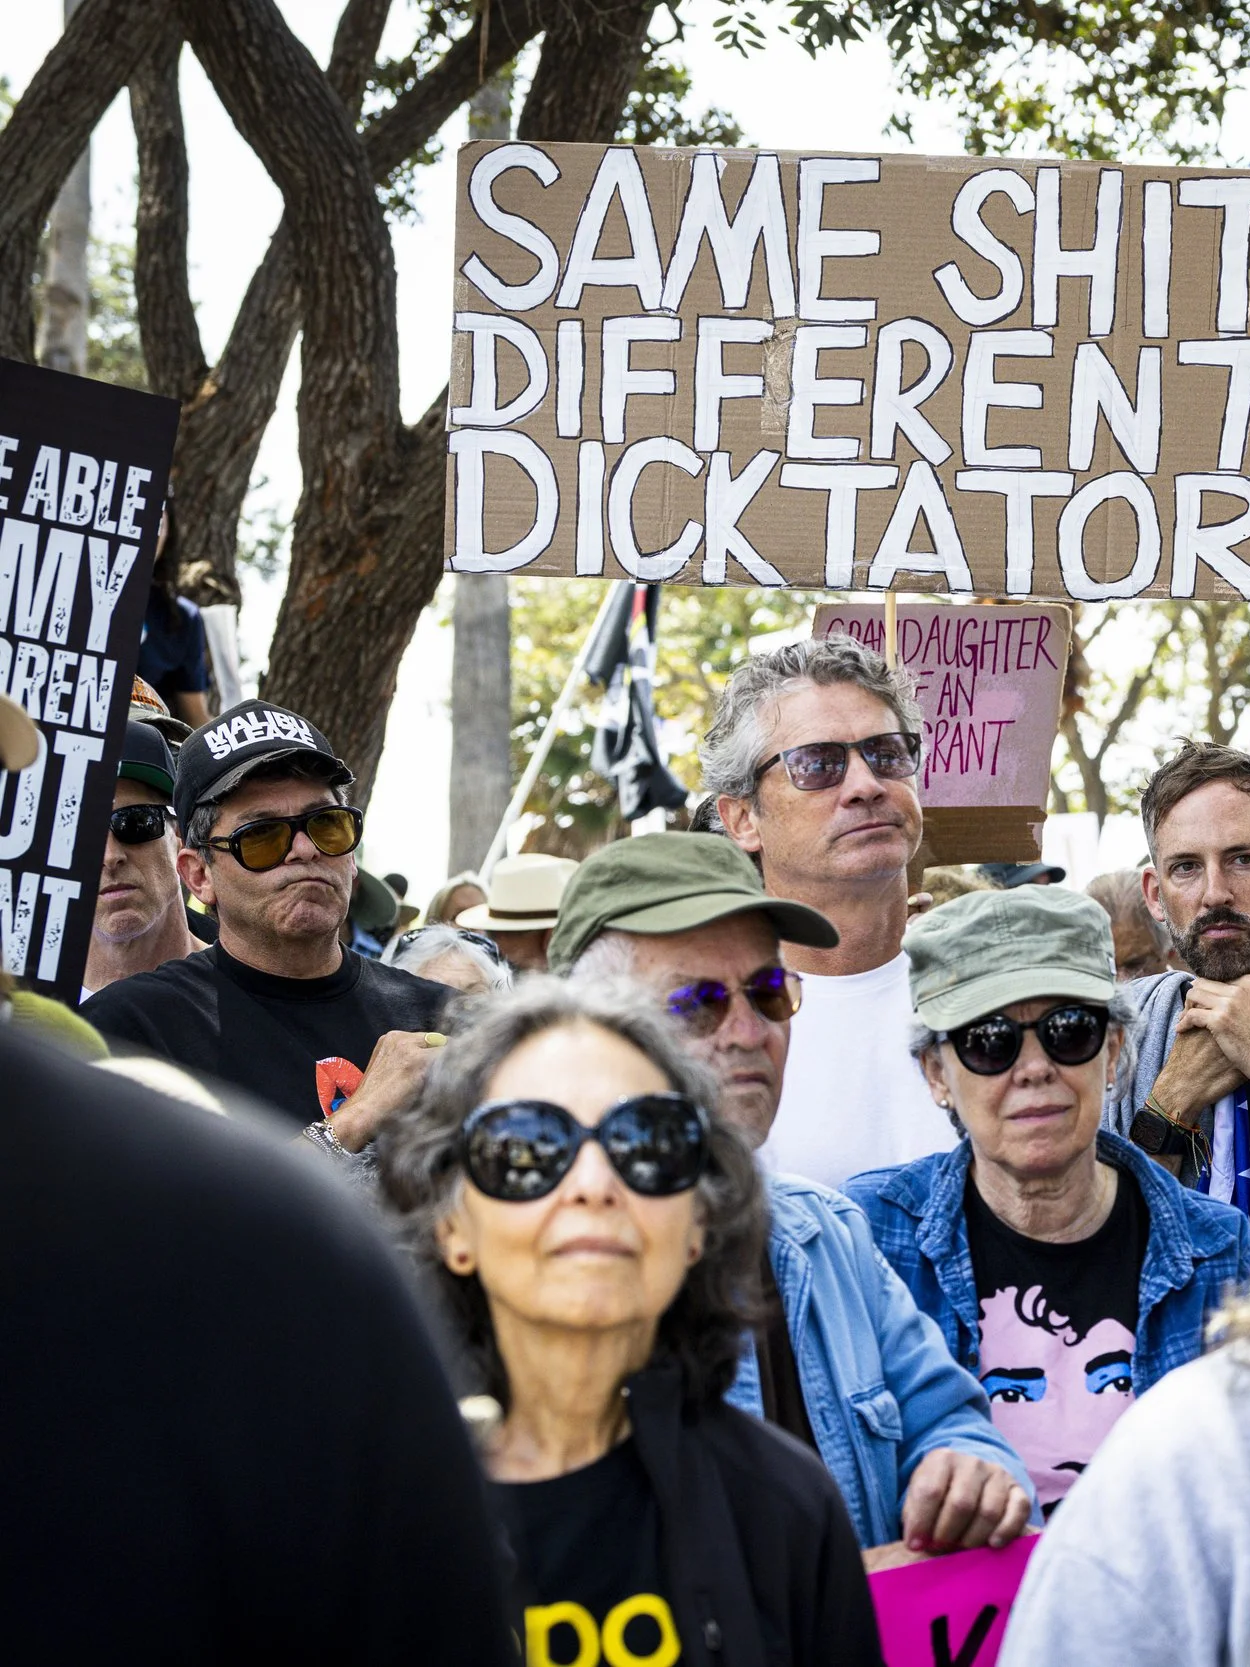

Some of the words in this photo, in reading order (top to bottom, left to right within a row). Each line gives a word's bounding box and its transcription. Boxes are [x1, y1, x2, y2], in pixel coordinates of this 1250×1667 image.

[460, 142, 882, 323] SAME
[20, 444, 153, 541] ABLE
[0, 516, 141, 654] MY
[203, 710, 312, 750] MALIBU
[936, 671, 977, 718] AN
